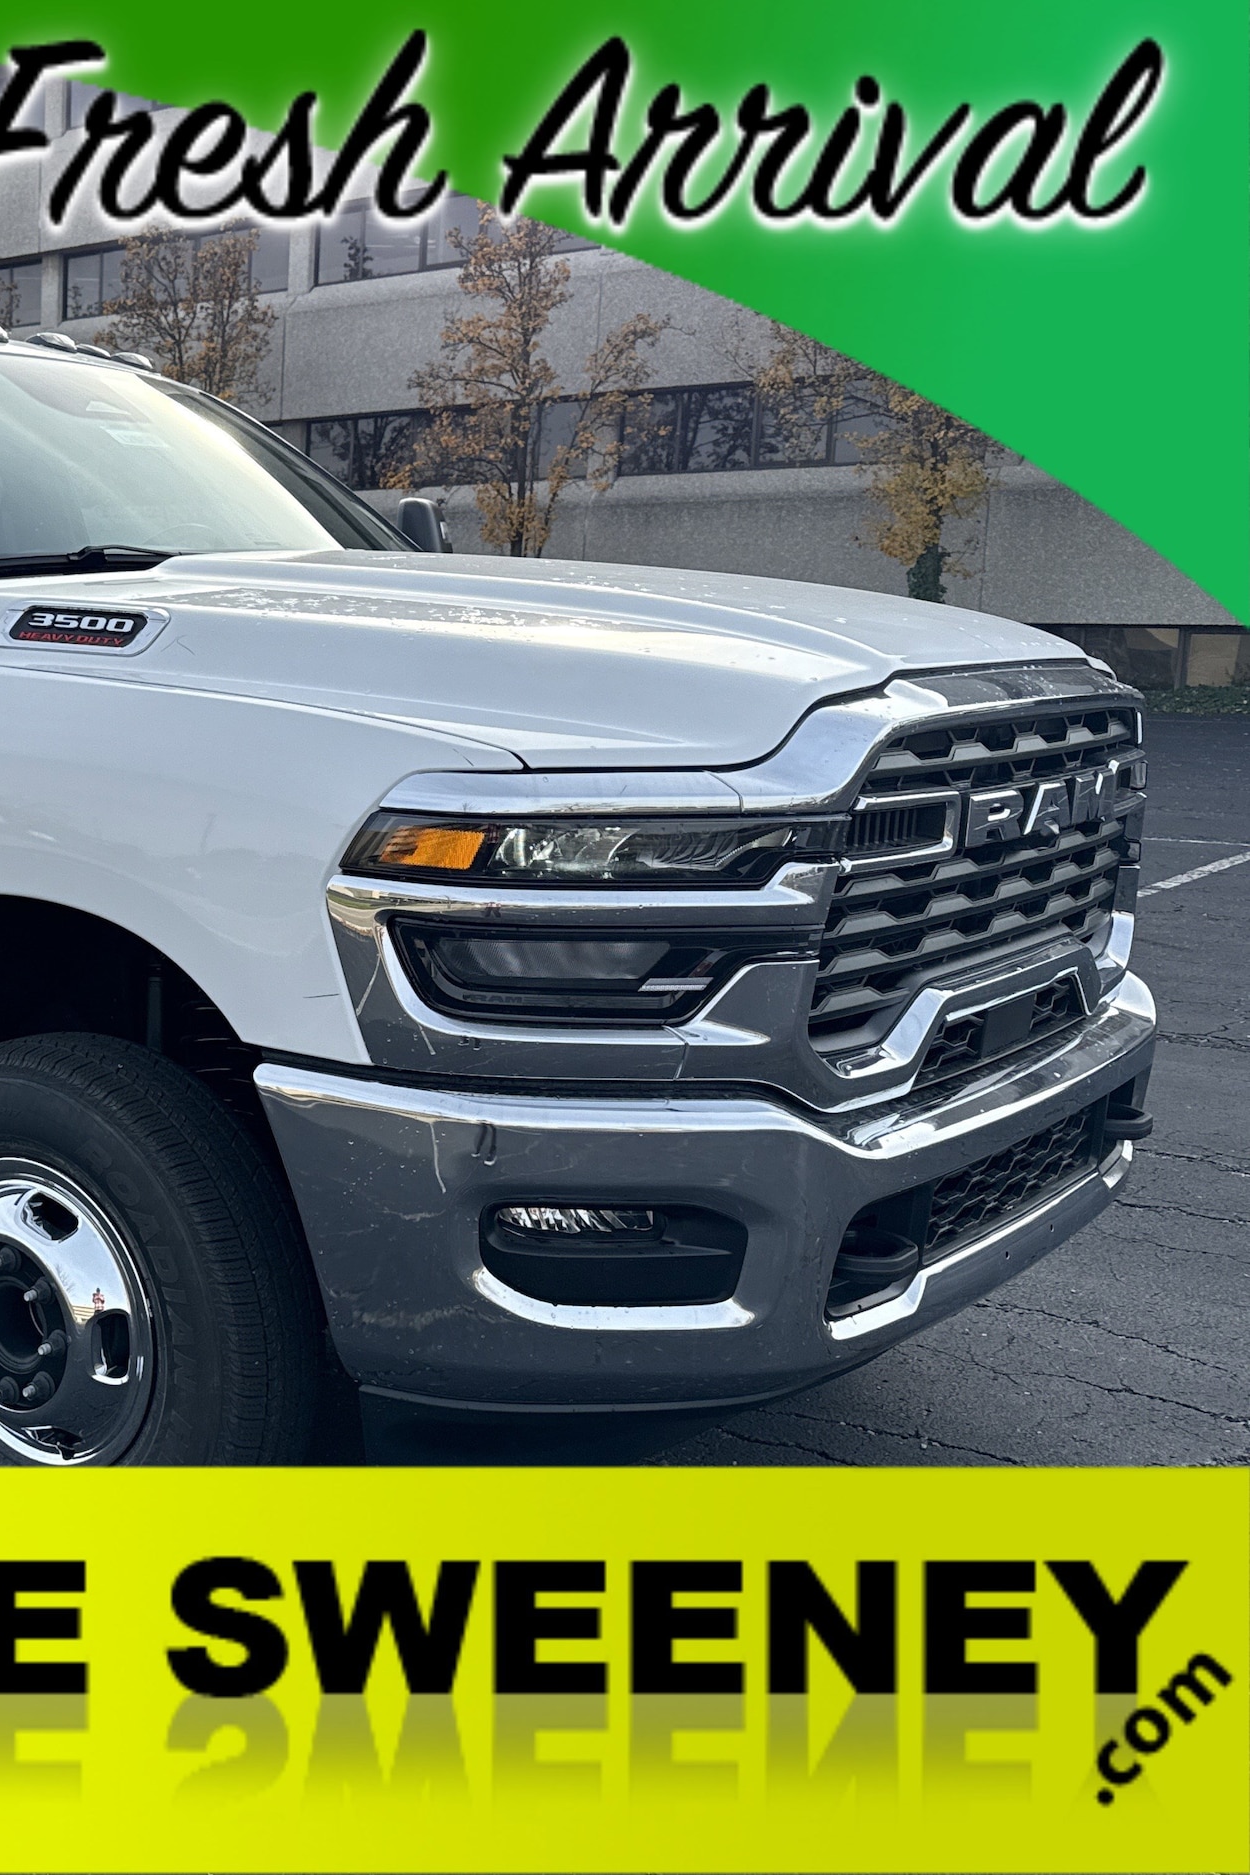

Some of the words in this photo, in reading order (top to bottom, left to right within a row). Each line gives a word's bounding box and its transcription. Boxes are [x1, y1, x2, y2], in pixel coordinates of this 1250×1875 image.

[28, 612, 135, 633] 3500
[18, 631, 76, 643] HEAVY
[76, 635, 124, 646] DUTY
[965, 760, 1118, 848] RAM
